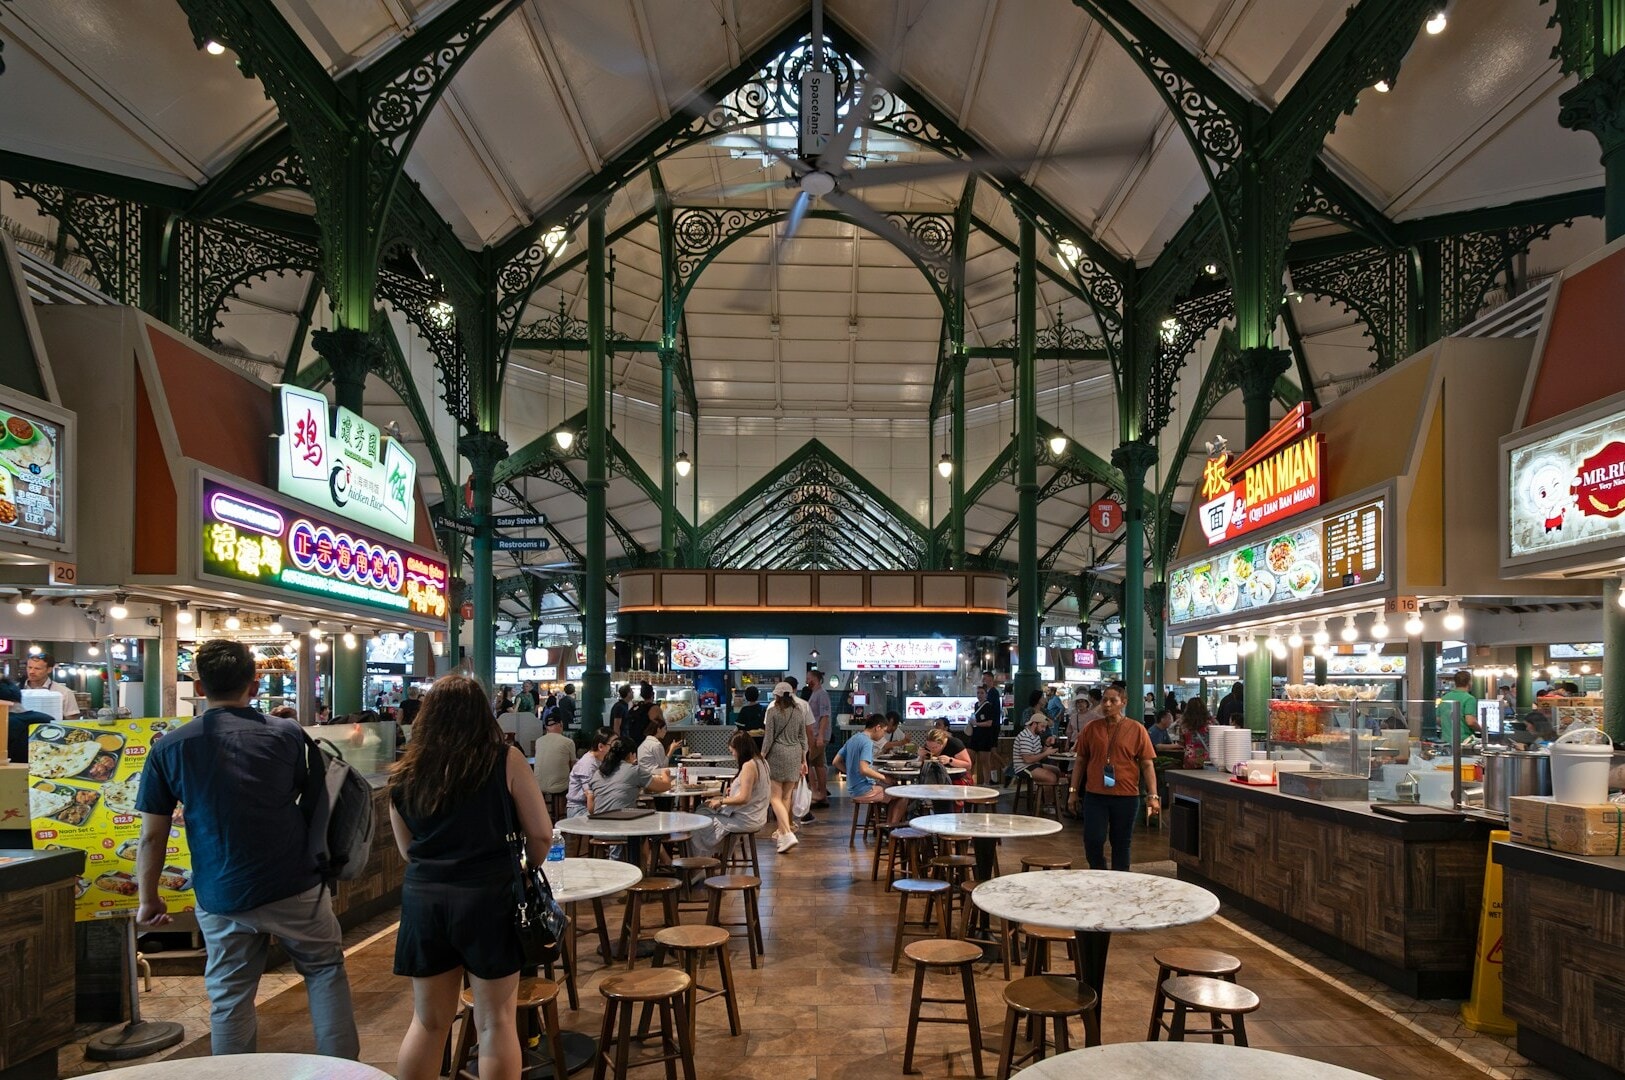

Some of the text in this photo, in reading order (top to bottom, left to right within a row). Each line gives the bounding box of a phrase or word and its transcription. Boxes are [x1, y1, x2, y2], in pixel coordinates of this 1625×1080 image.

[811, 78, 820, 135] Spacefans
[294, 408, 323, 467] 鸡
[30, 464, 40, 473] 14
[1245, 435, 1316, 508] BAN MIAN
[1583, 461, 1625, 487] MR.RI
[1202, 454, 1231, 500] 板
[497, 517, 537, 526] Satay Street
[1102, 512, 1110, 528] 6
[296, 531, 399, 582] 正宗海南鸡饭
[57, 567, 75, 580] 20
[1387, 600, 1396, 610] 16
[1401, 600, 1414, 610] 16
[125, 747, 146, 755] $12.5
